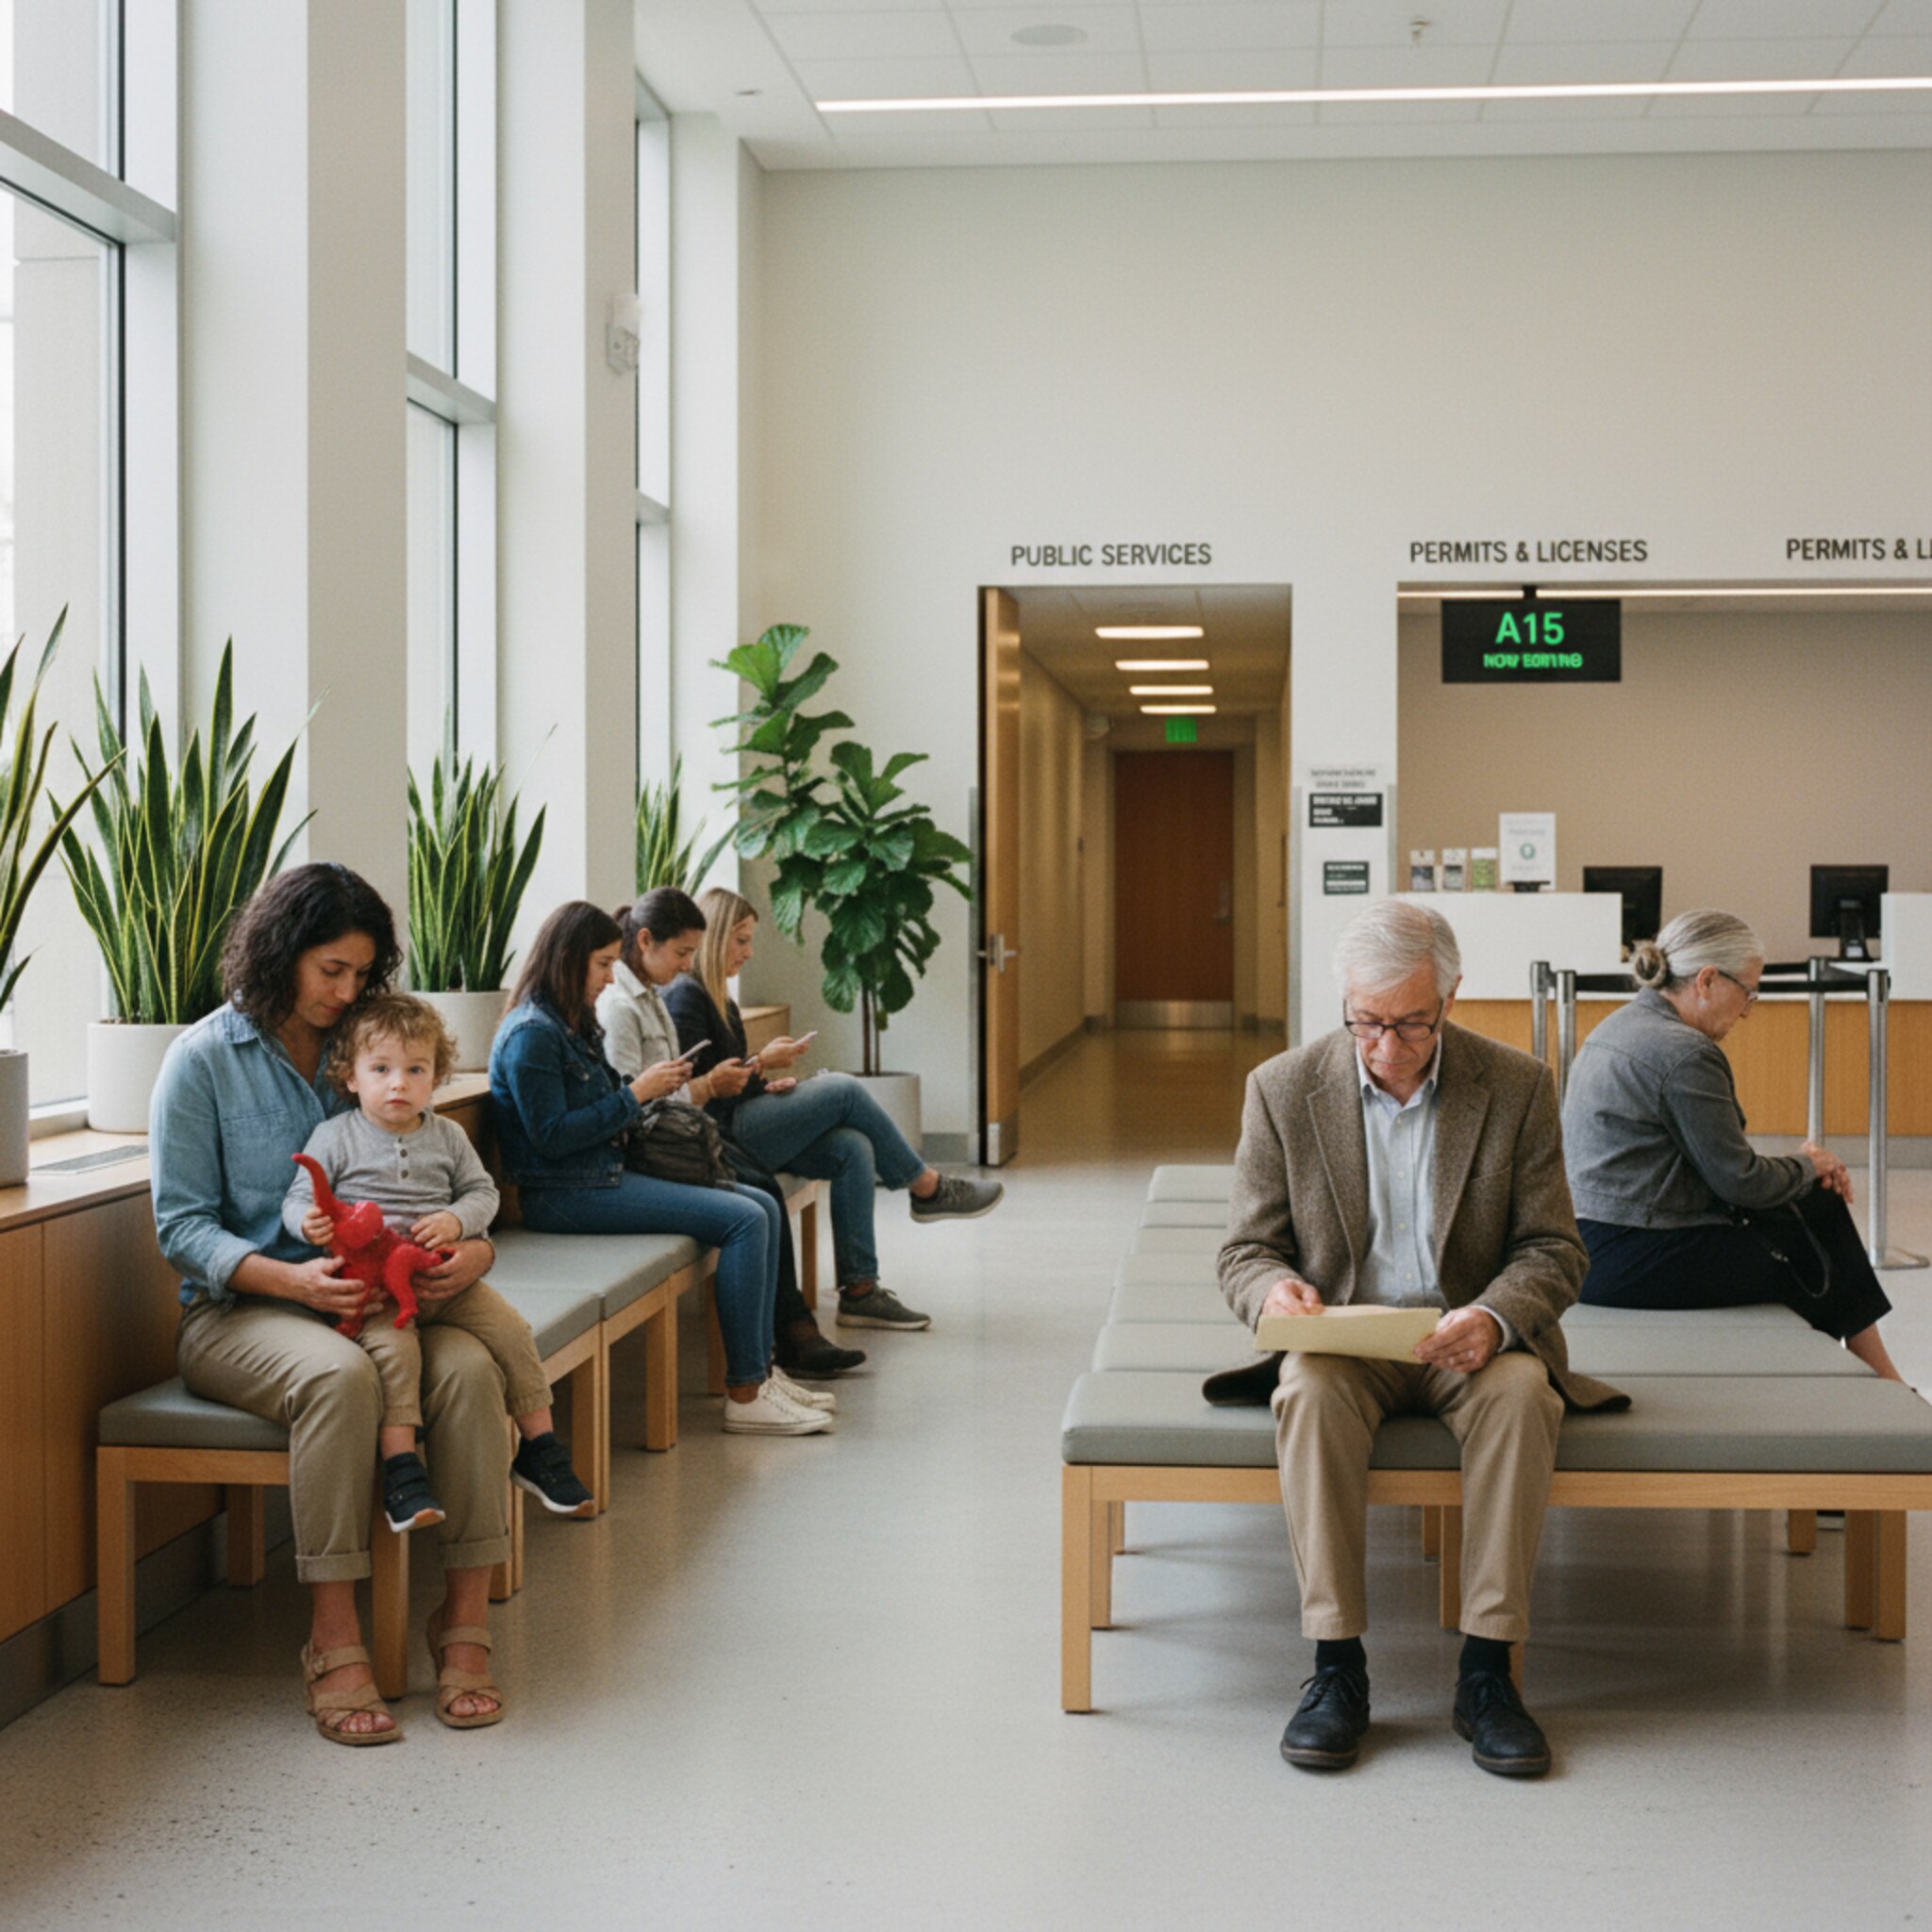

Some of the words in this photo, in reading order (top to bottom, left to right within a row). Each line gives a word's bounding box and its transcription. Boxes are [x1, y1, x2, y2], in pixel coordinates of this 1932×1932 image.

[1011, 544, 1092, 566] PUBLIC
[1101, 542, 1212, 566] SERVICES
[1410, 541, 1507, 563] PERMITS
[1515, 541, 1529, 563] &
[1537, 540, 1648, 563] LICENSES
[1787, 538, 1886, 560] PERMITS
[1893, 538, 1908, 560] &
[1495, 611, 1565, 645] A15
